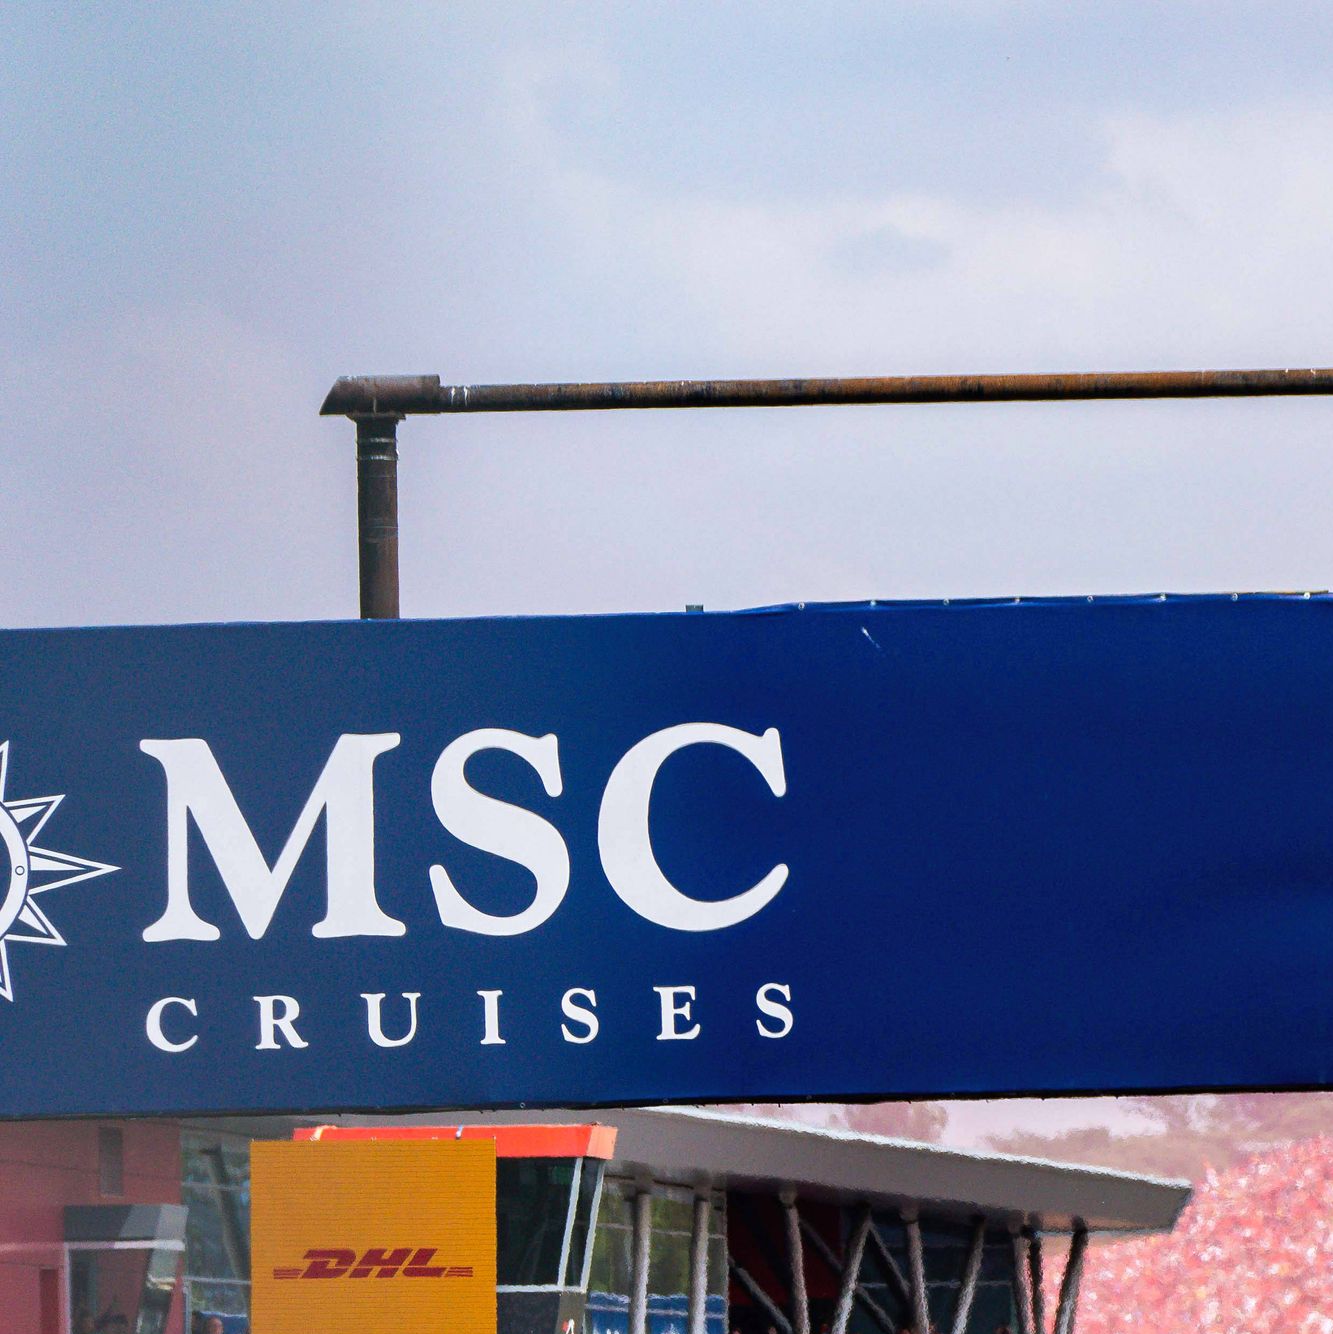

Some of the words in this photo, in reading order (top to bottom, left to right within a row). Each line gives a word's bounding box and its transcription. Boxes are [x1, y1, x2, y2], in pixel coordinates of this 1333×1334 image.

[140, 722, 788, 942] MSC
[145, 982, 794, 1053] CRUISES
[301, 1248, 438, 1279] DHL
